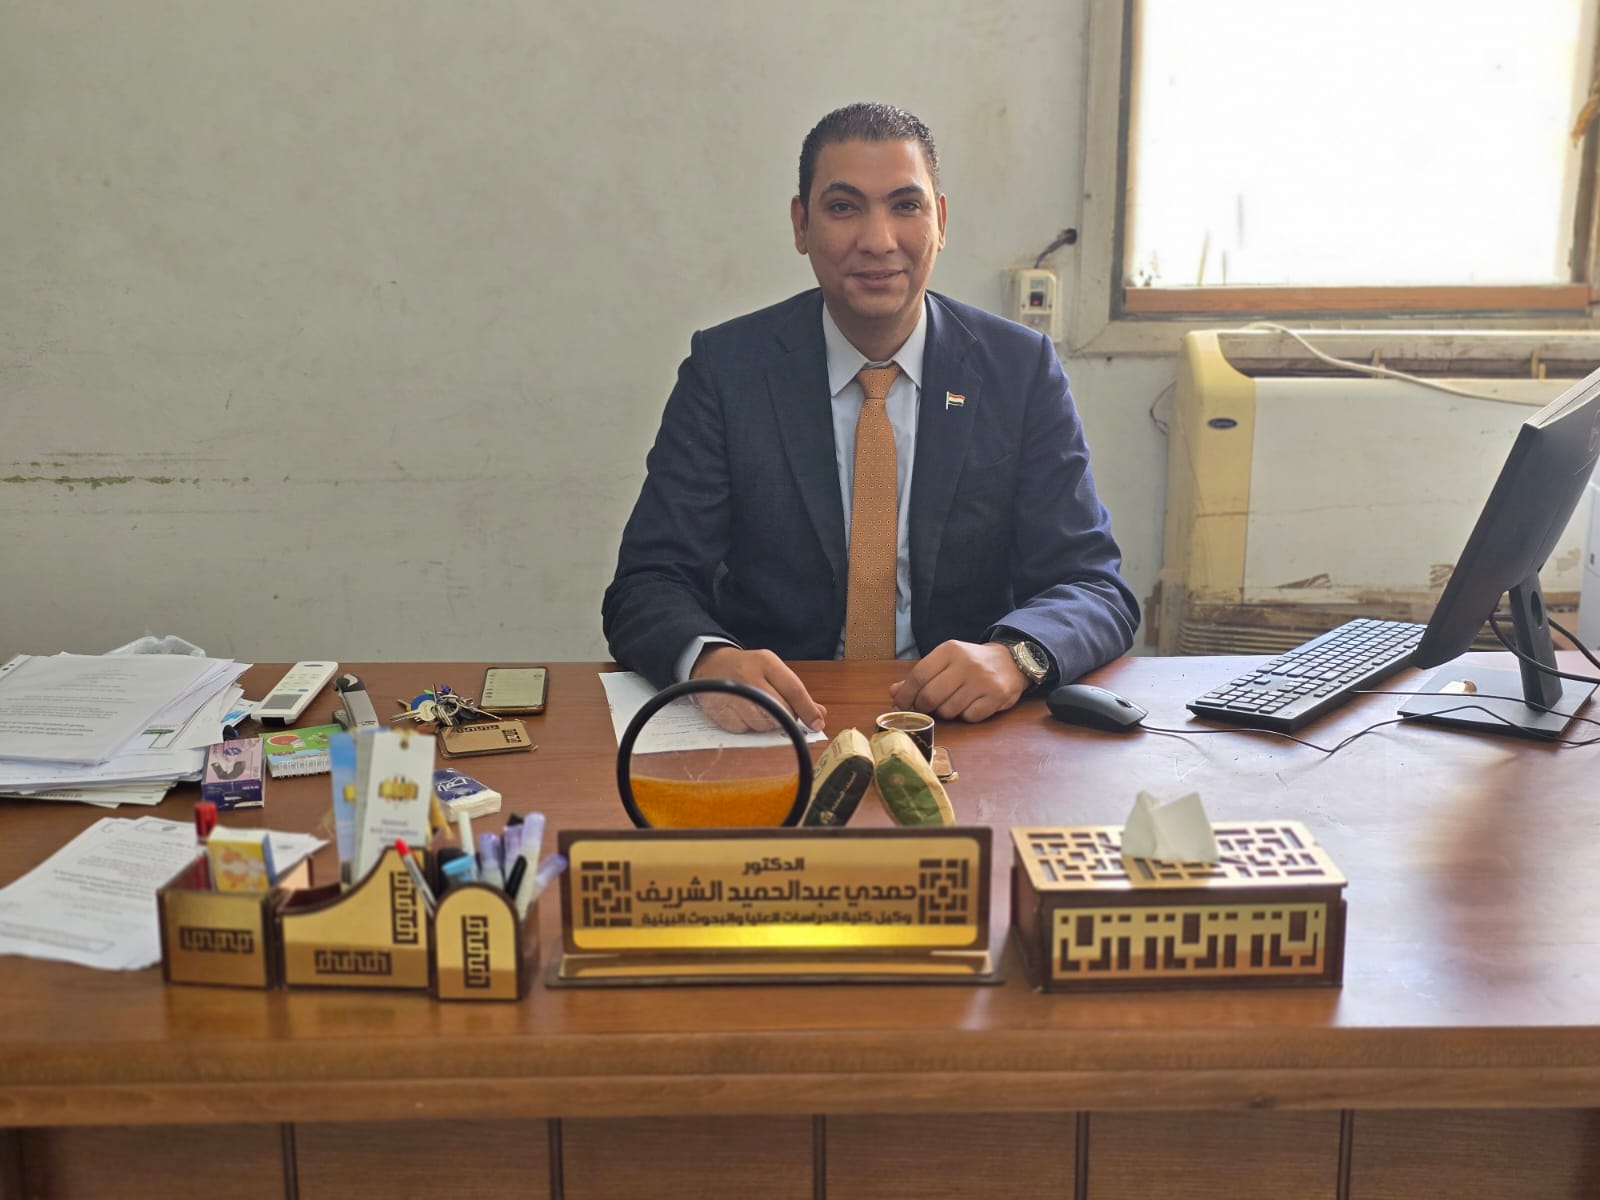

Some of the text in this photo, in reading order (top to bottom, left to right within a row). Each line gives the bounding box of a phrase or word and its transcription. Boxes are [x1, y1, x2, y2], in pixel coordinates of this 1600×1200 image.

[743, 857, 804, 874] الدكتور
[634, 875, 722, 909] الشريف
[845, 884, 916, 907] حمدي
[688, 911, 745, 926] والبحوث
[747, 911, 780, 927] العليا
[783, 911, 840, 926] الدراسات
[842, 911, 872, 925] كلية
[876, 911, 912, 925] وكيل
